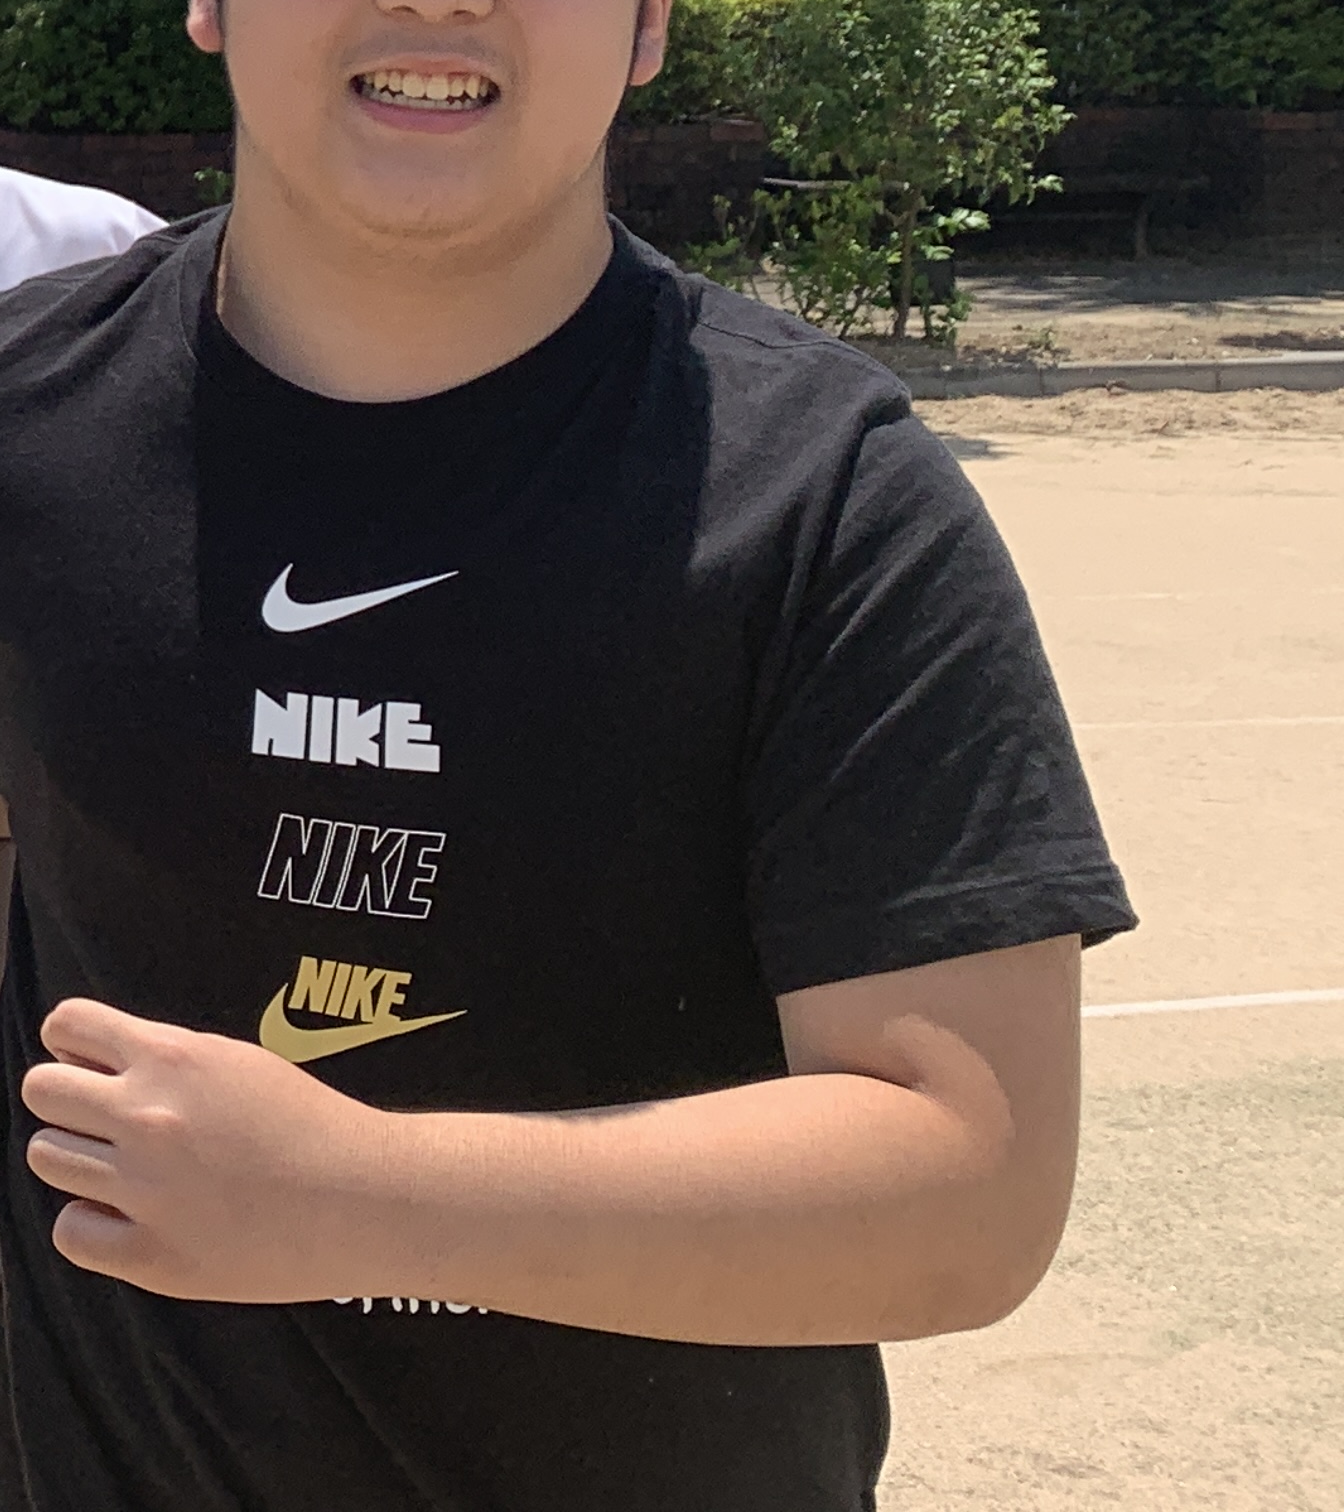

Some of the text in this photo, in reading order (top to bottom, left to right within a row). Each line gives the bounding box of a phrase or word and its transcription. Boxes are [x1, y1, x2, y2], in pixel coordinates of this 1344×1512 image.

[252, 688, 441, 773] NIKE
[258, 813, 446, 919] NIKE
[288, 955, 412, 1022] NIKE
